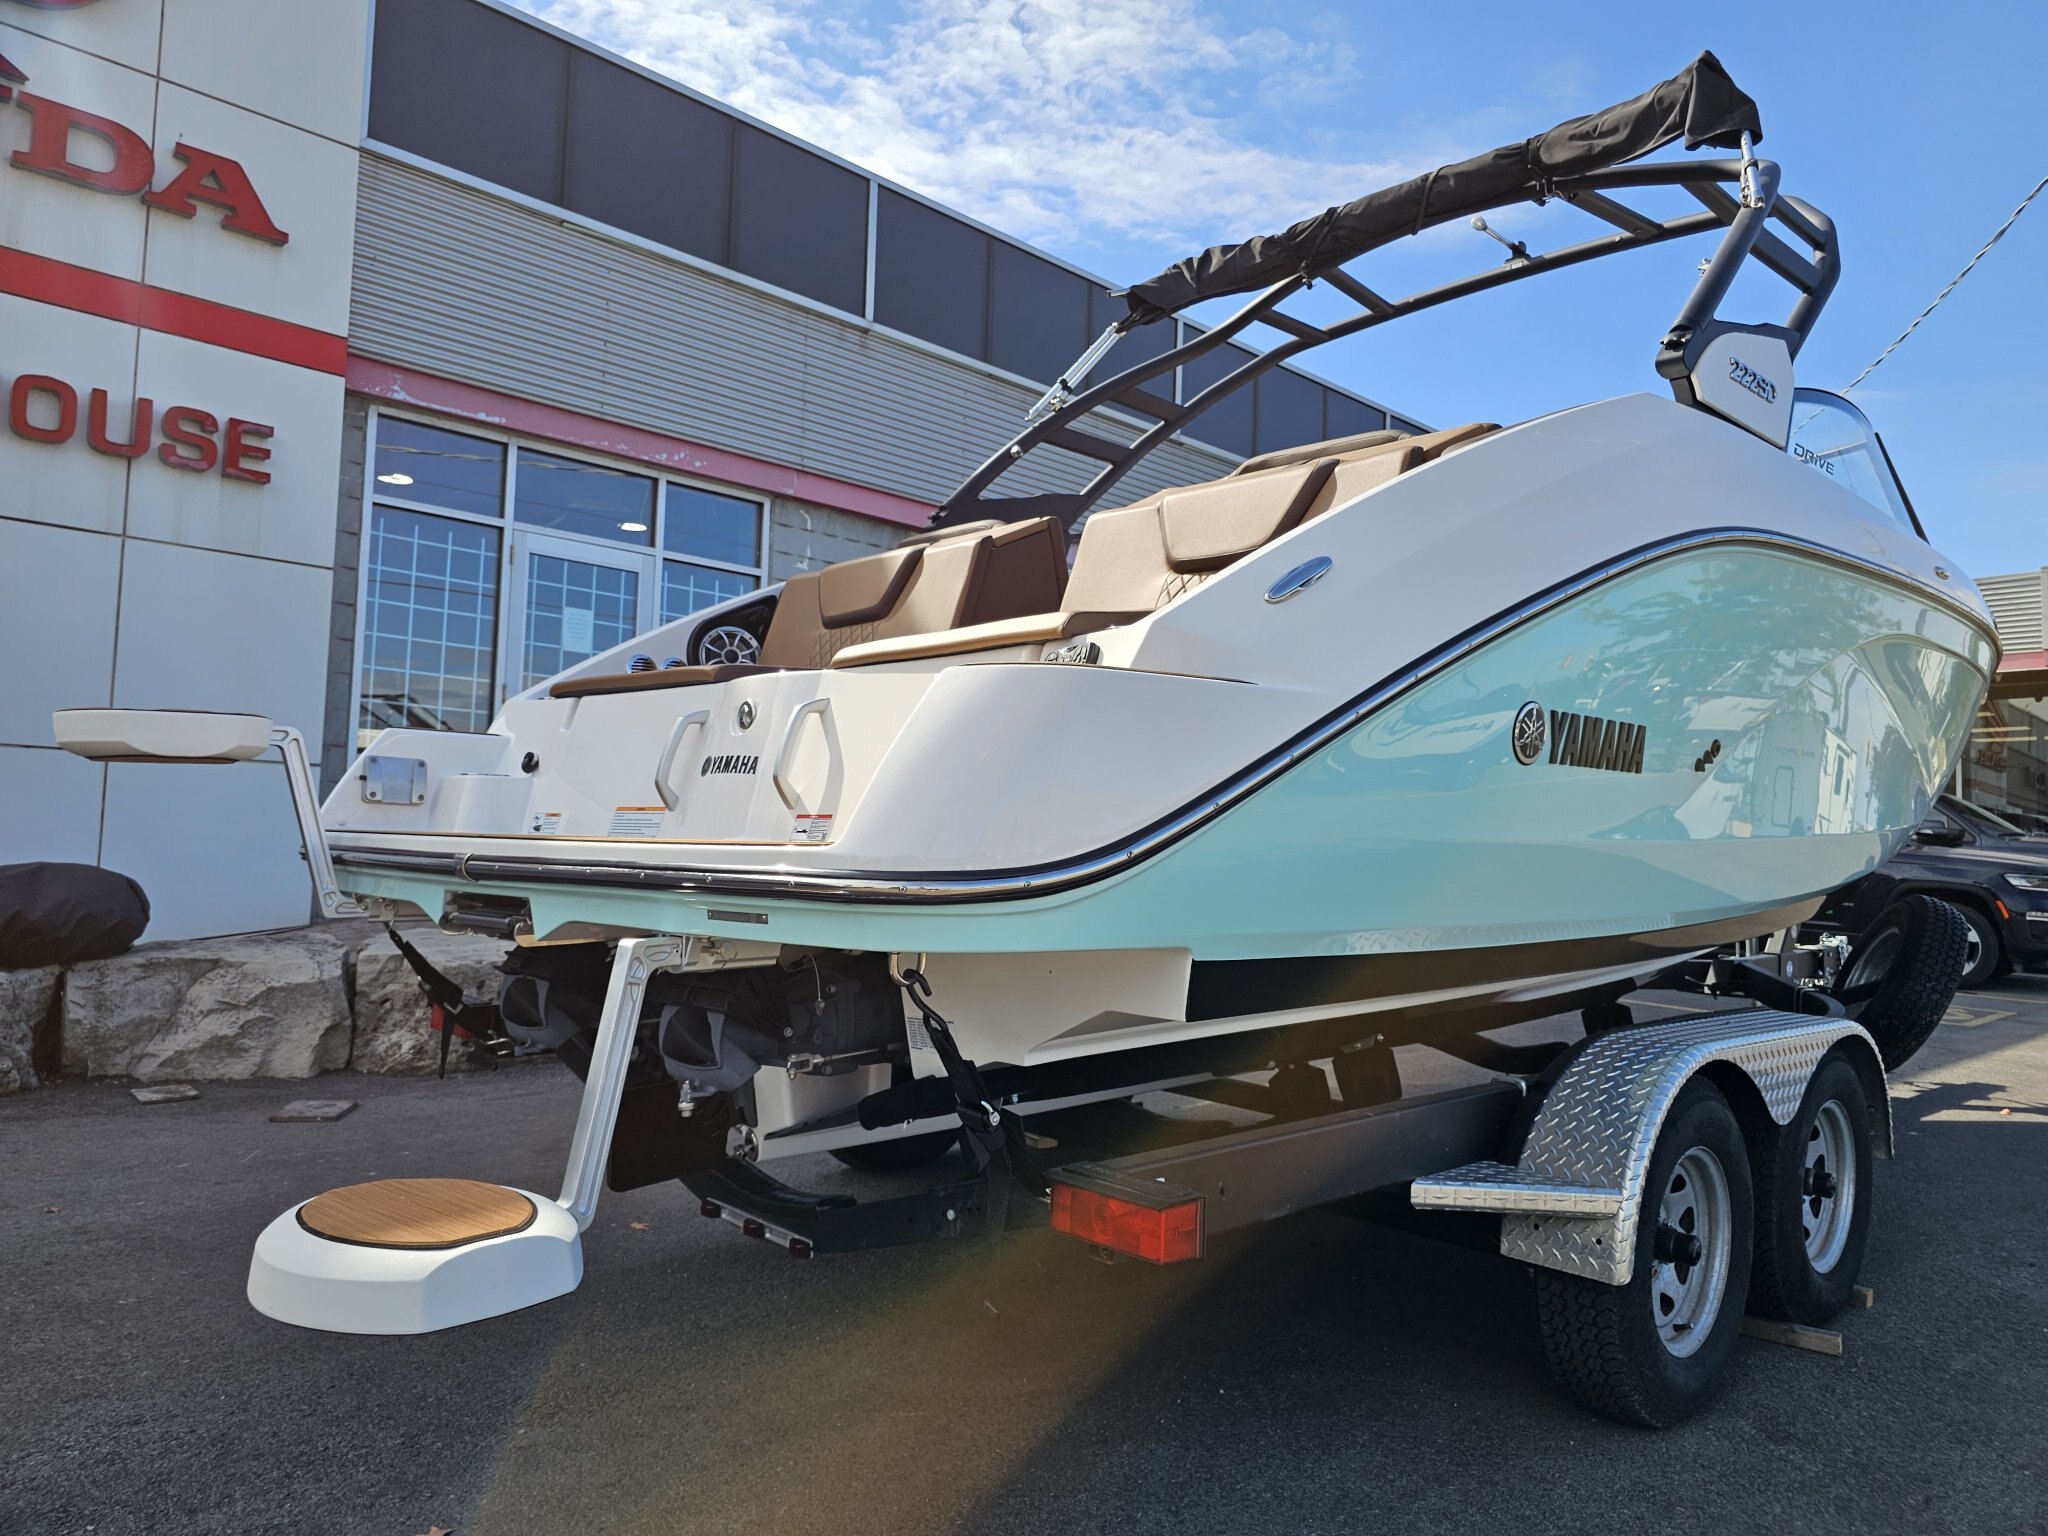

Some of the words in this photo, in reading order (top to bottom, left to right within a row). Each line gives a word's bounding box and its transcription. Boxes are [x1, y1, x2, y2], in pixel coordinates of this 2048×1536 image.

[0, 84, 289, 247] DA
[710, 755, 759, 775] YAMAHA
[1548, 709, 1647, 774] YAMAHA
